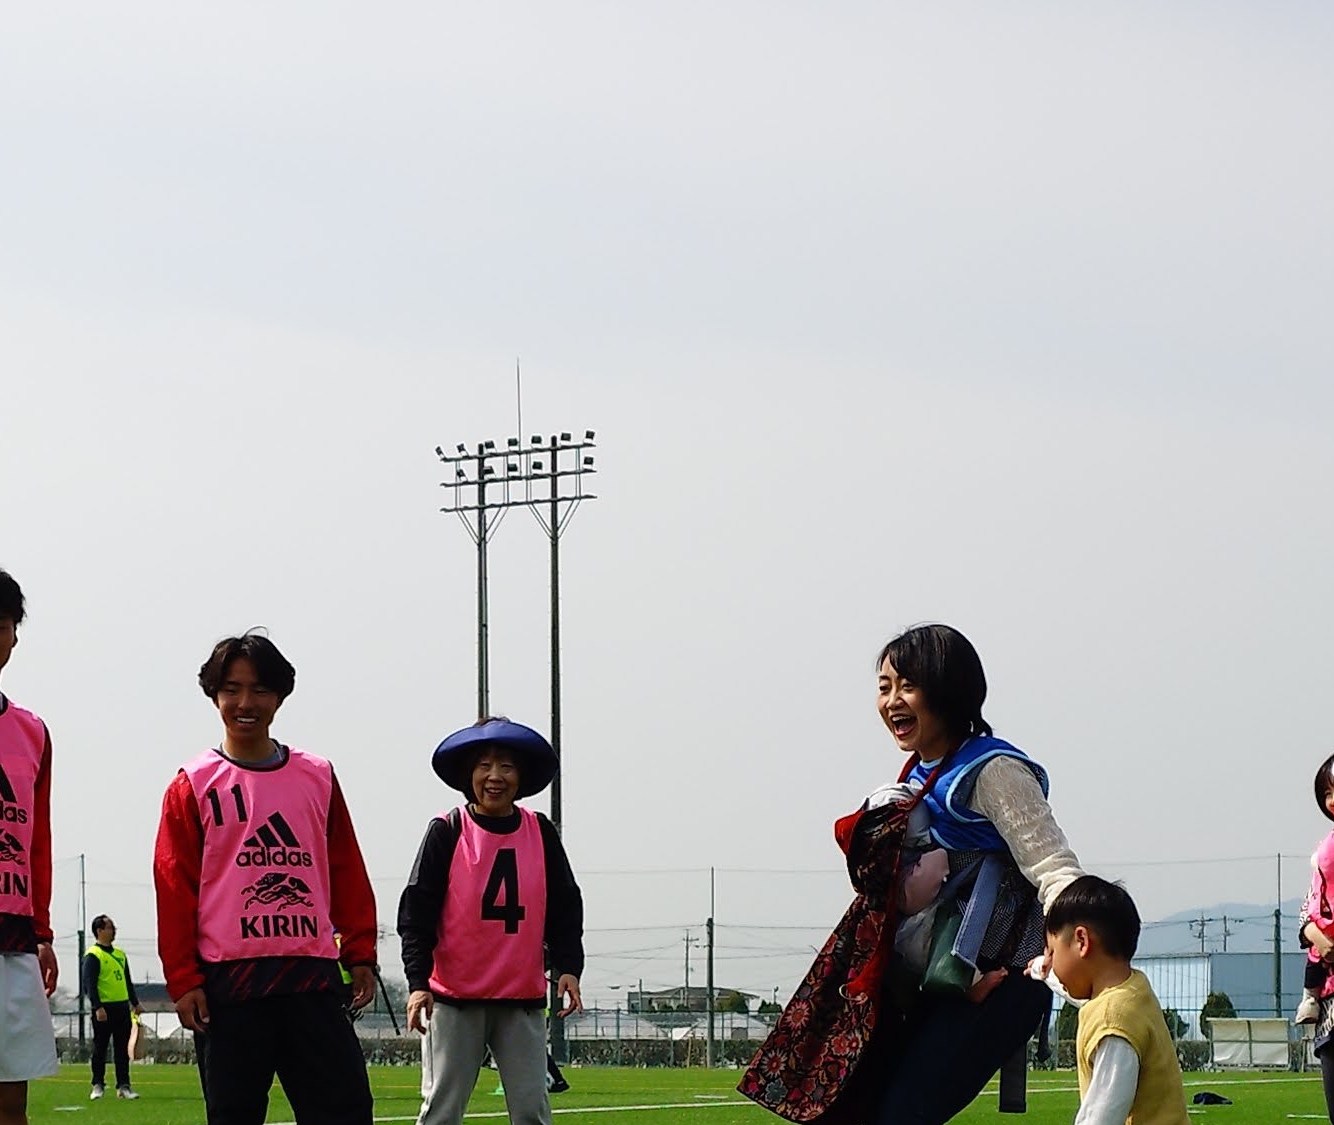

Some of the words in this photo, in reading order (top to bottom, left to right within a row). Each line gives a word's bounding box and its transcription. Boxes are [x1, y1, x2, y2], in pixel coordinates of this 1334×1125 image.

[207, 783, 248, 827] 11
[236, 847, 313, 867] adidas
[481, 848, 526, 935] 4
[240, 915, 318, 939] KIRIN
